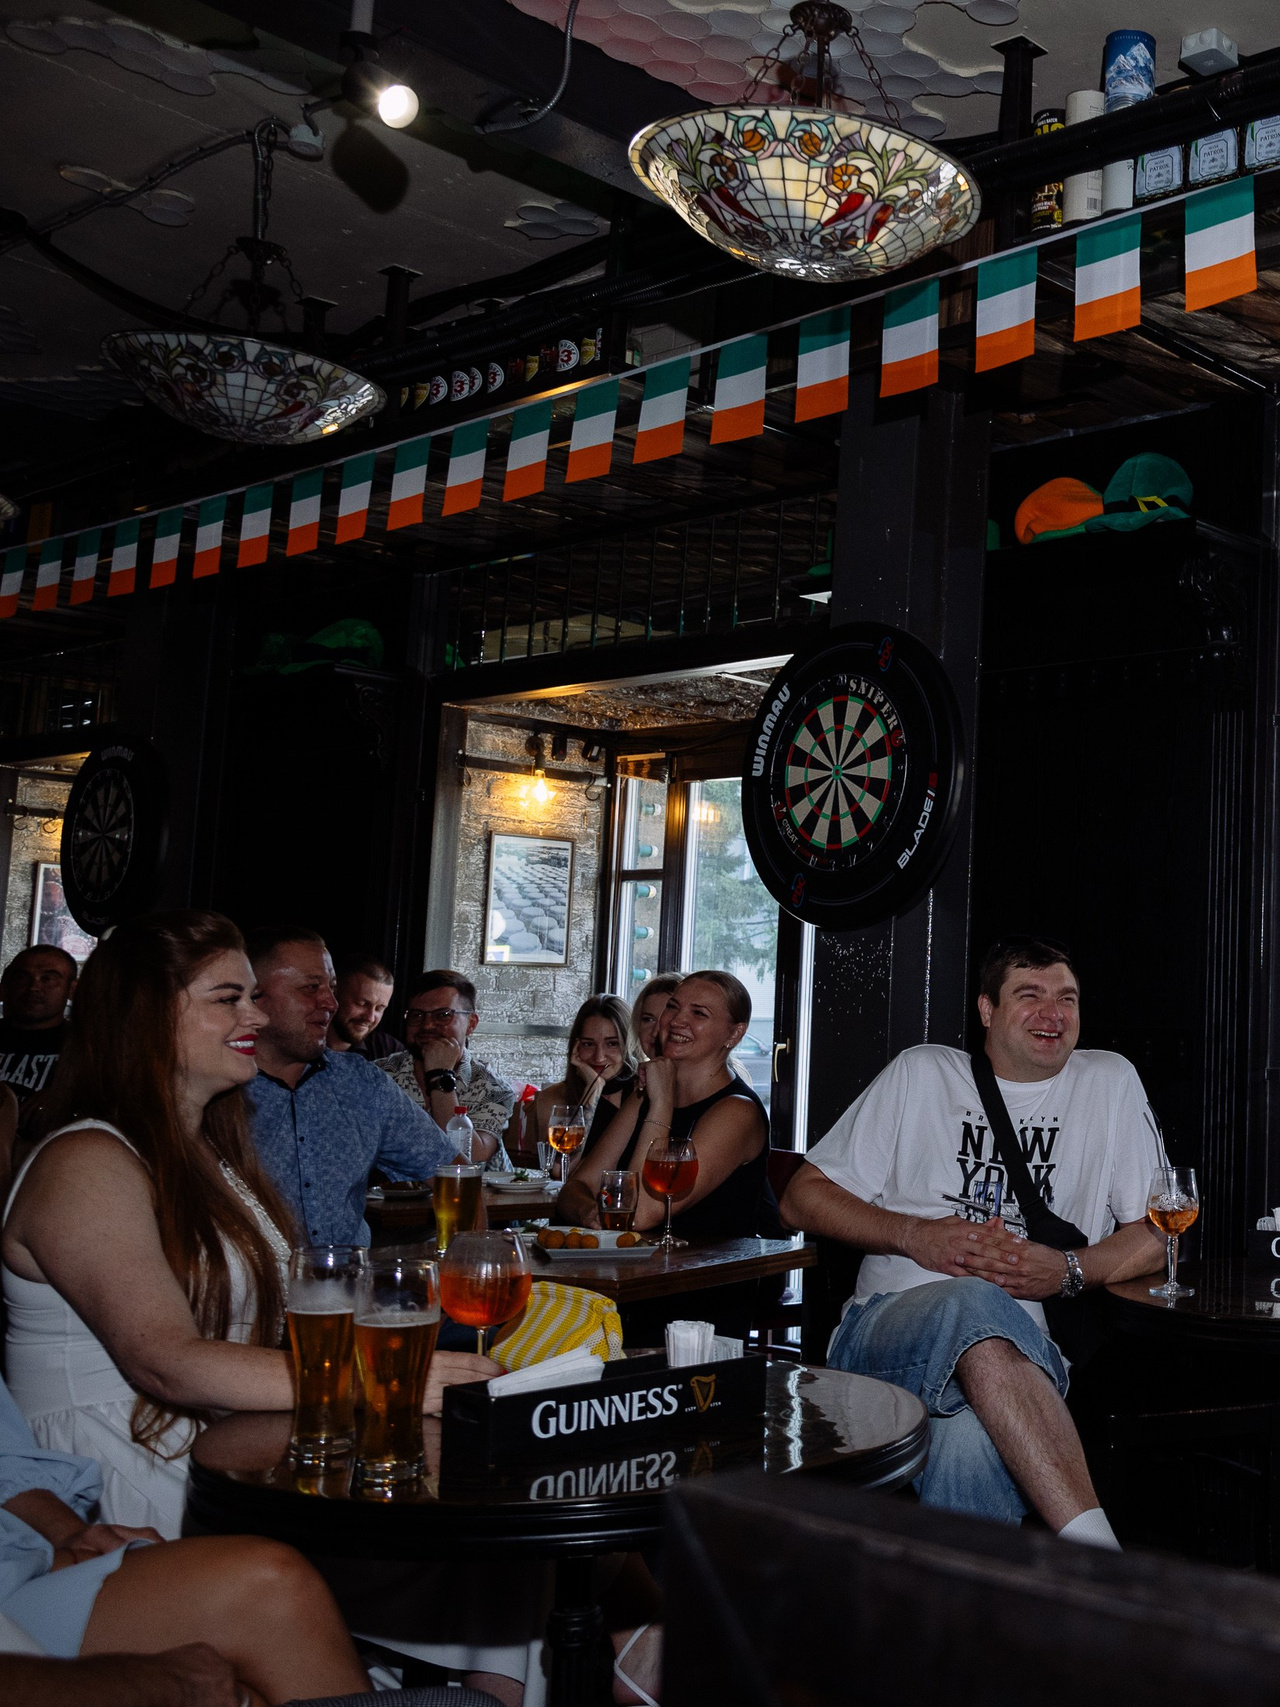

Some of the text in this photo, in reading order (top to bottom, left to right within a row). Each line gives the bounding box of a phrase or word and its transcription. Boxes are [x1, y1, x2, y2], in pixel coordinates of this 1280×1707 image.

[877, 640, 894, 668] PDC
[752, 684, 792, 777] WINMAU
[848, 679, 899, 732] SNIPER
[896, 799, 933, 869] BLADE
[966, 1110, 1058, 1125] BRKLYN
[530, 1384, 680, 1439] GUINNESS
